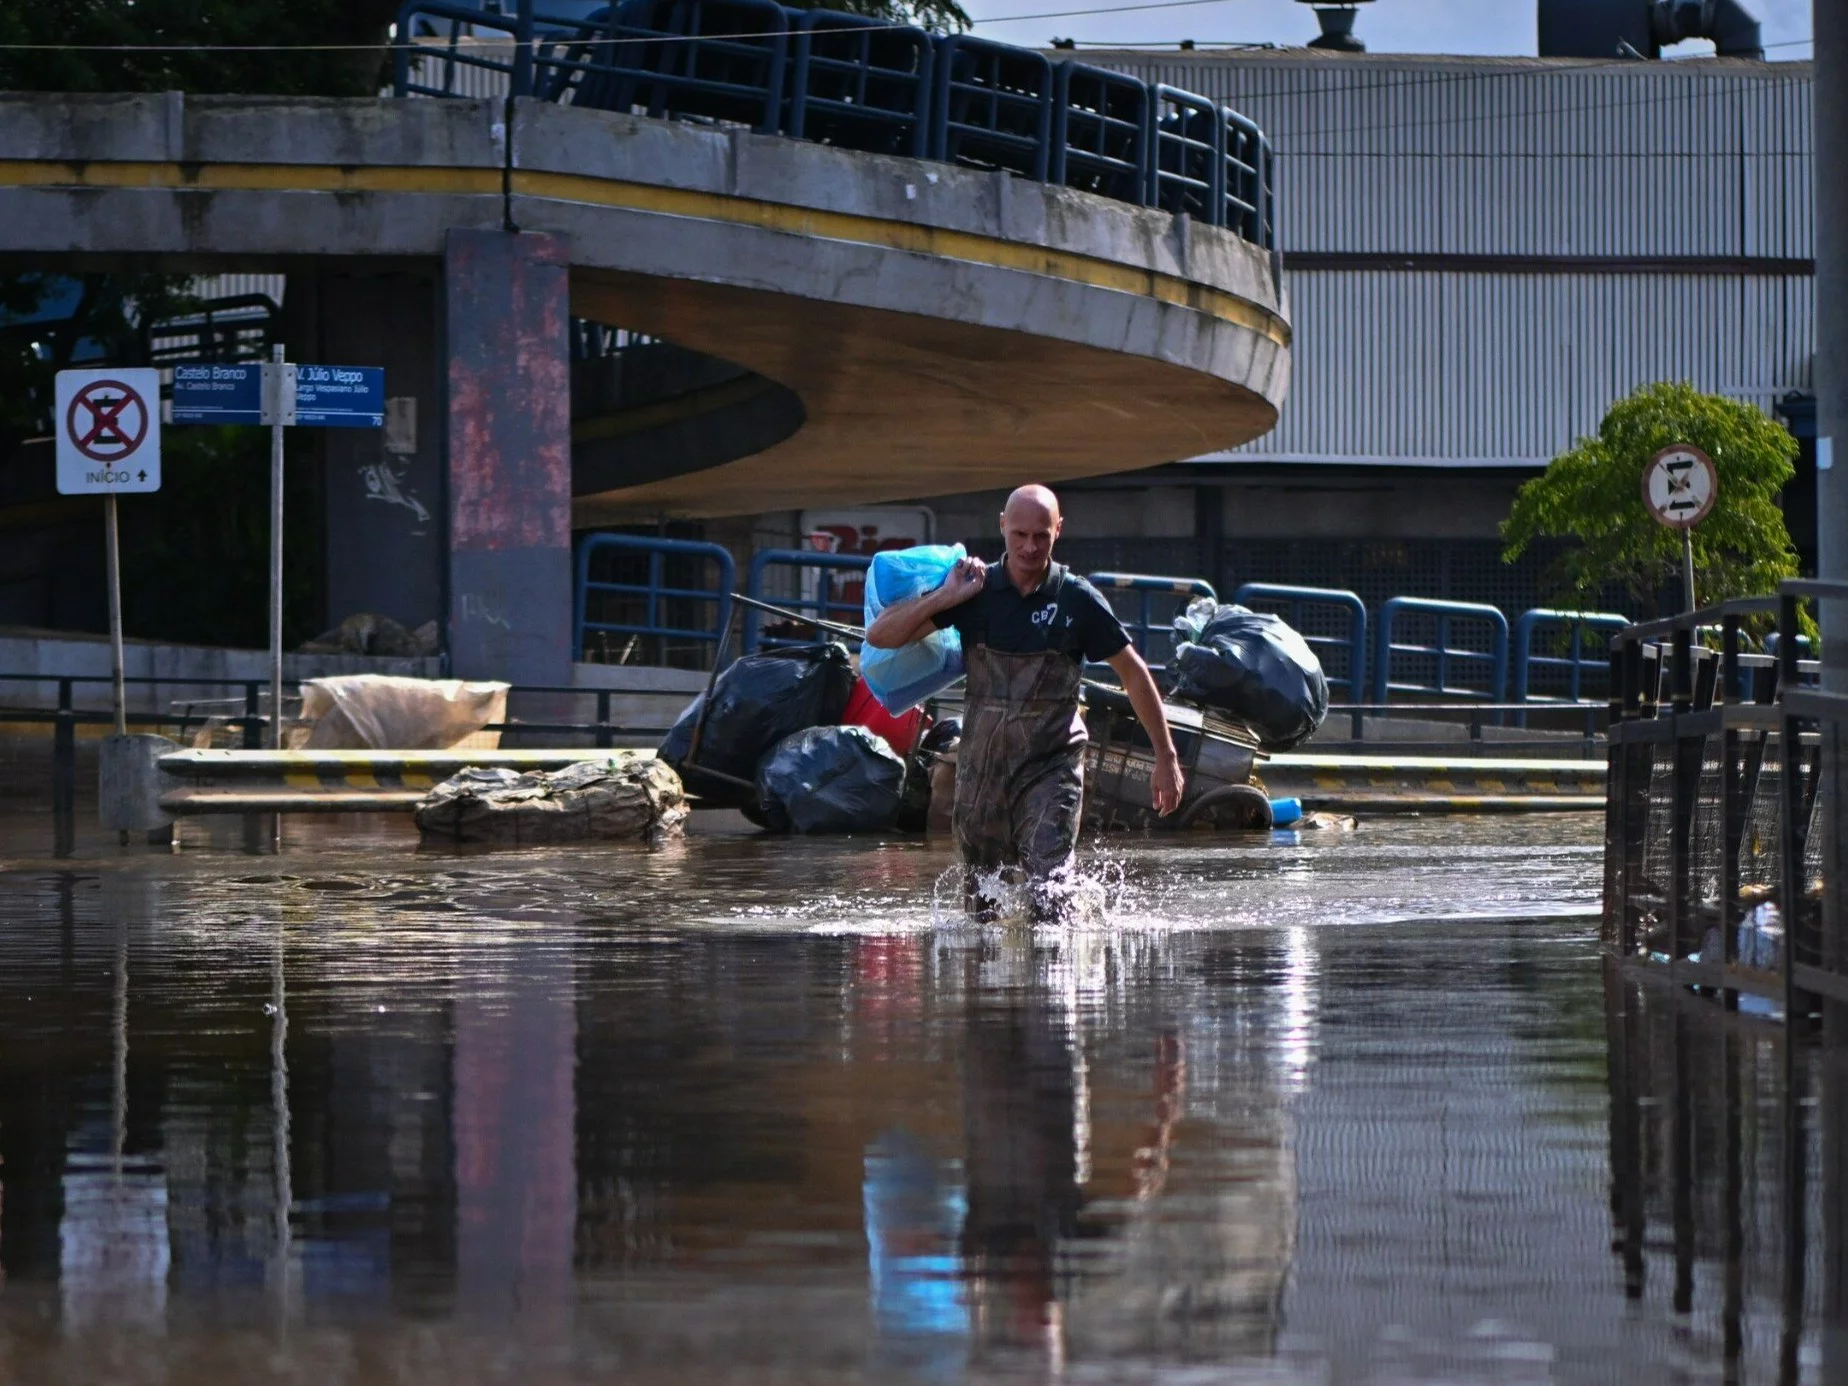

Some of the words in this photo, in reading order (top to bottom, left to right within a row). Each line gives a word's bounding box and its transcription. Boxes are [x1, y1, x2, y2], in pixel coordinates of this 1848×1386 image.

[175, 366, 210, 380] Castelo
[212, 366, 247, 380] Branco
[307, 367, 330, 381] Júlio
[332, 368, 363, 384] Veppo
[372, 416, 382, 426] 70
[86, 470, 130, 483] INÍCIO
